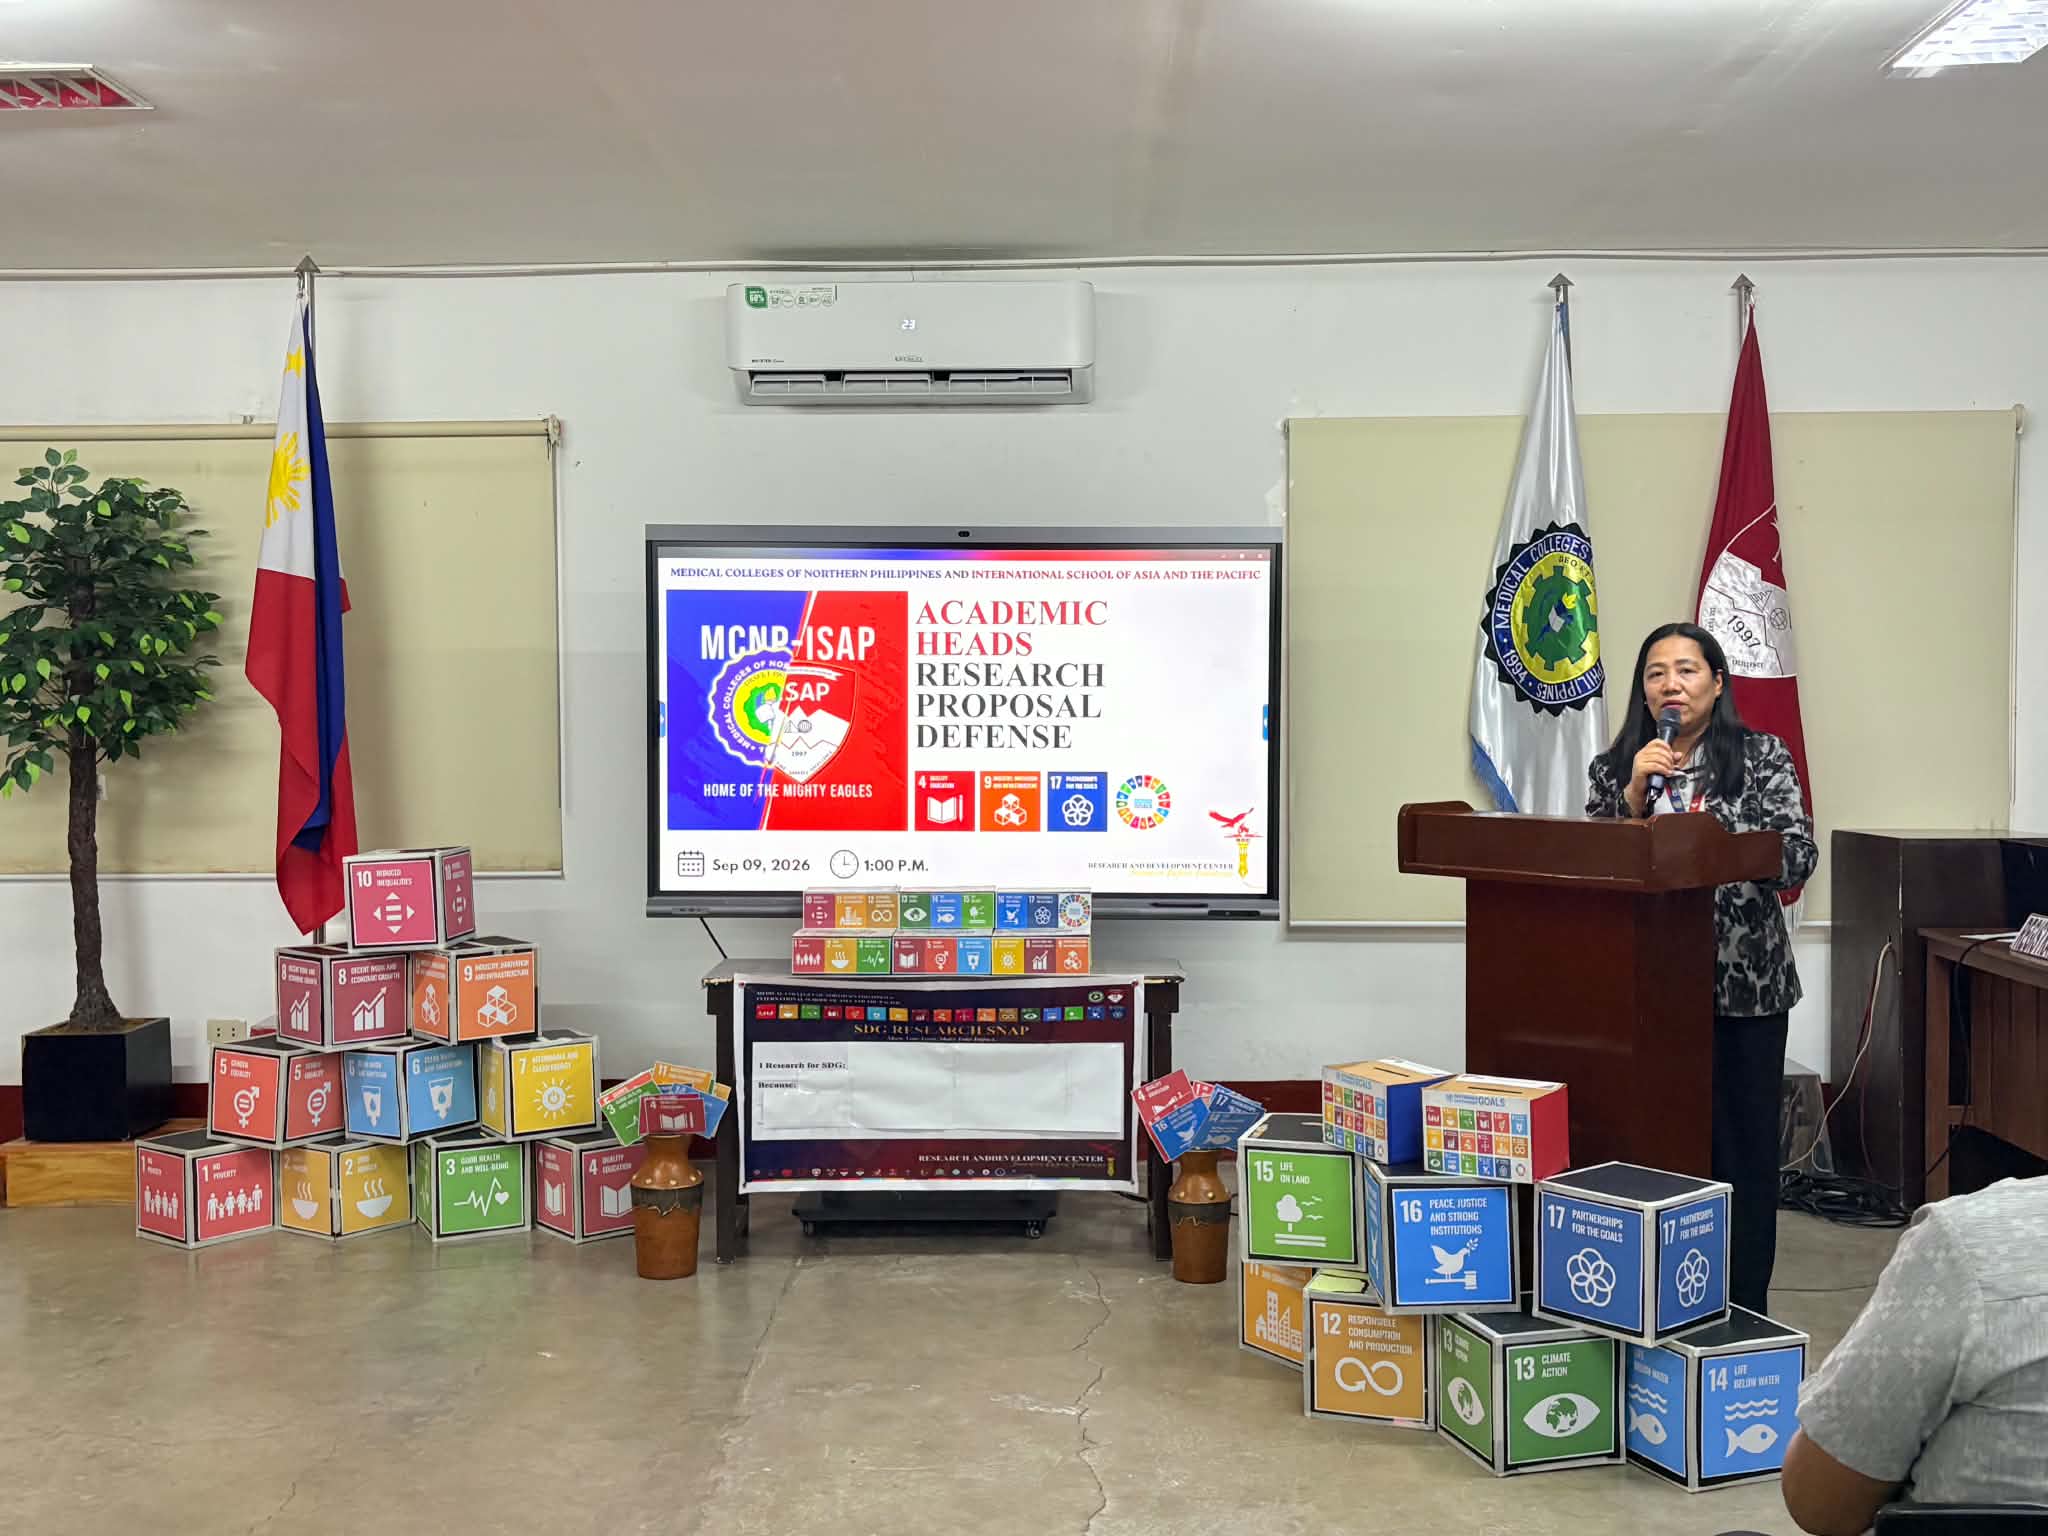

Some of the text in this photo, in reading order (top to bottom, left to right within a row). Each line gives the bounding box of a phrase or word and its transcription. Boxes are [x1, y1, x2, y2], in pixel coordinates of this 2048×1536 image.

[670, 568, 1261, 580] MEDICAL COLLEGES OF NORTHERN PHILIPPINES AND INTERNATIONAL SCHOOL OF ASIA AND THE PACIFIC
[1495, 562, 1529, 629] MEDICAL
[1530, 535, 1590, 562] COLLEGES
[915, 600, 1108, 625] ACADEMIC
[1728, 614, 1761, 648] 1997
[701, 625, 876, 660] MCNP-ISAP
[916, 631, 1033, 656] HEADS
[915, 662, 1105, 688] RESEARCH
[1502, 649, 1526, 684] 1994
[723, 664, 751, 709] COLLEGES
[754, 660, 766, 669] OF
[916, 693, 1102, 719] PROPOSAL
[916, 724, 1073, 749] DEFENSE
[703, 783, 873, 798] HOME OF THE MIGHTY EAGLES
[918, 776, 926, 789] 4
[984, 776, 992, 789] 9
[1050, 776, 1062, 790] 17
[712, 858, 810, 874] Sep 09, 2026
[864, 859, 929, 871] 1:00 P.M.
[356, 870, 372, 888] 10
[338, 968, 347, 985] 8
[464, 965, 473, 982] 9
[220, 1057, 227, 1075] 5
[294, 1063, 302, 1080] 5
[412, 1057, 420, 1075] 6
[519, 1057, 527, 1075] 7
[766, 1061, 804, 1069] Research
[1138, 1090, 1145, 1101] 4
[1216, 1094, 1228, 1106] 17
[1479, 1095, 1505, 1107] GOALS
[446, 1158, 456, 1175] 3
[589, 1158, 598, 1175] 4
[918, 1154, 970, 1162] RESEARCH
[202, 1162, 221, 1182] 1 NO
[213, 1169, 237, 1180] POVERTY
[345, 1158, 353, 1176] 2
[461, 1165, 474, 1174] AND
[1254, 1160, 1294, 1182] 15 LIFE
[1280, 1174, 1310, 1184] ON LAND
[1400, 1197, 1488, 1223] 16 PEACE, JUSTICE
[1430, 1211, 1479, 1222] AND STRONG
[1547, 1203, 1623, 1230] 17 PARTNERSHIPS
[1430, 1224, 1483, 1236] INSTITUTIONS
[1571, 1222, 1623, 1243] FOR THE GOALS
[1663, 1208, 1714, 1245] 17 PARTNERSHIPS
[1679, 1229, 1689, 1241] FOR
[1690, 1227, 1699, 1238] THE
[1320, 1311, 1397, 1335] 12 RESPONSIBLE
[1348, 1328, 1401, 1341] CONSUMPTION
[1442, 1327, 1453, 1353] 13
[1348, 1340, 1412, 1355] AND PRODUCTION
[1514, 1352, 1572, 1381] 13 CLIMATE
[1541, 1366, 1568, 1378] ACTION
[1708, 1364, 1748, 1392] 14 LIFE
[1734, 1375, 1780, 1389] BELOW WATER
